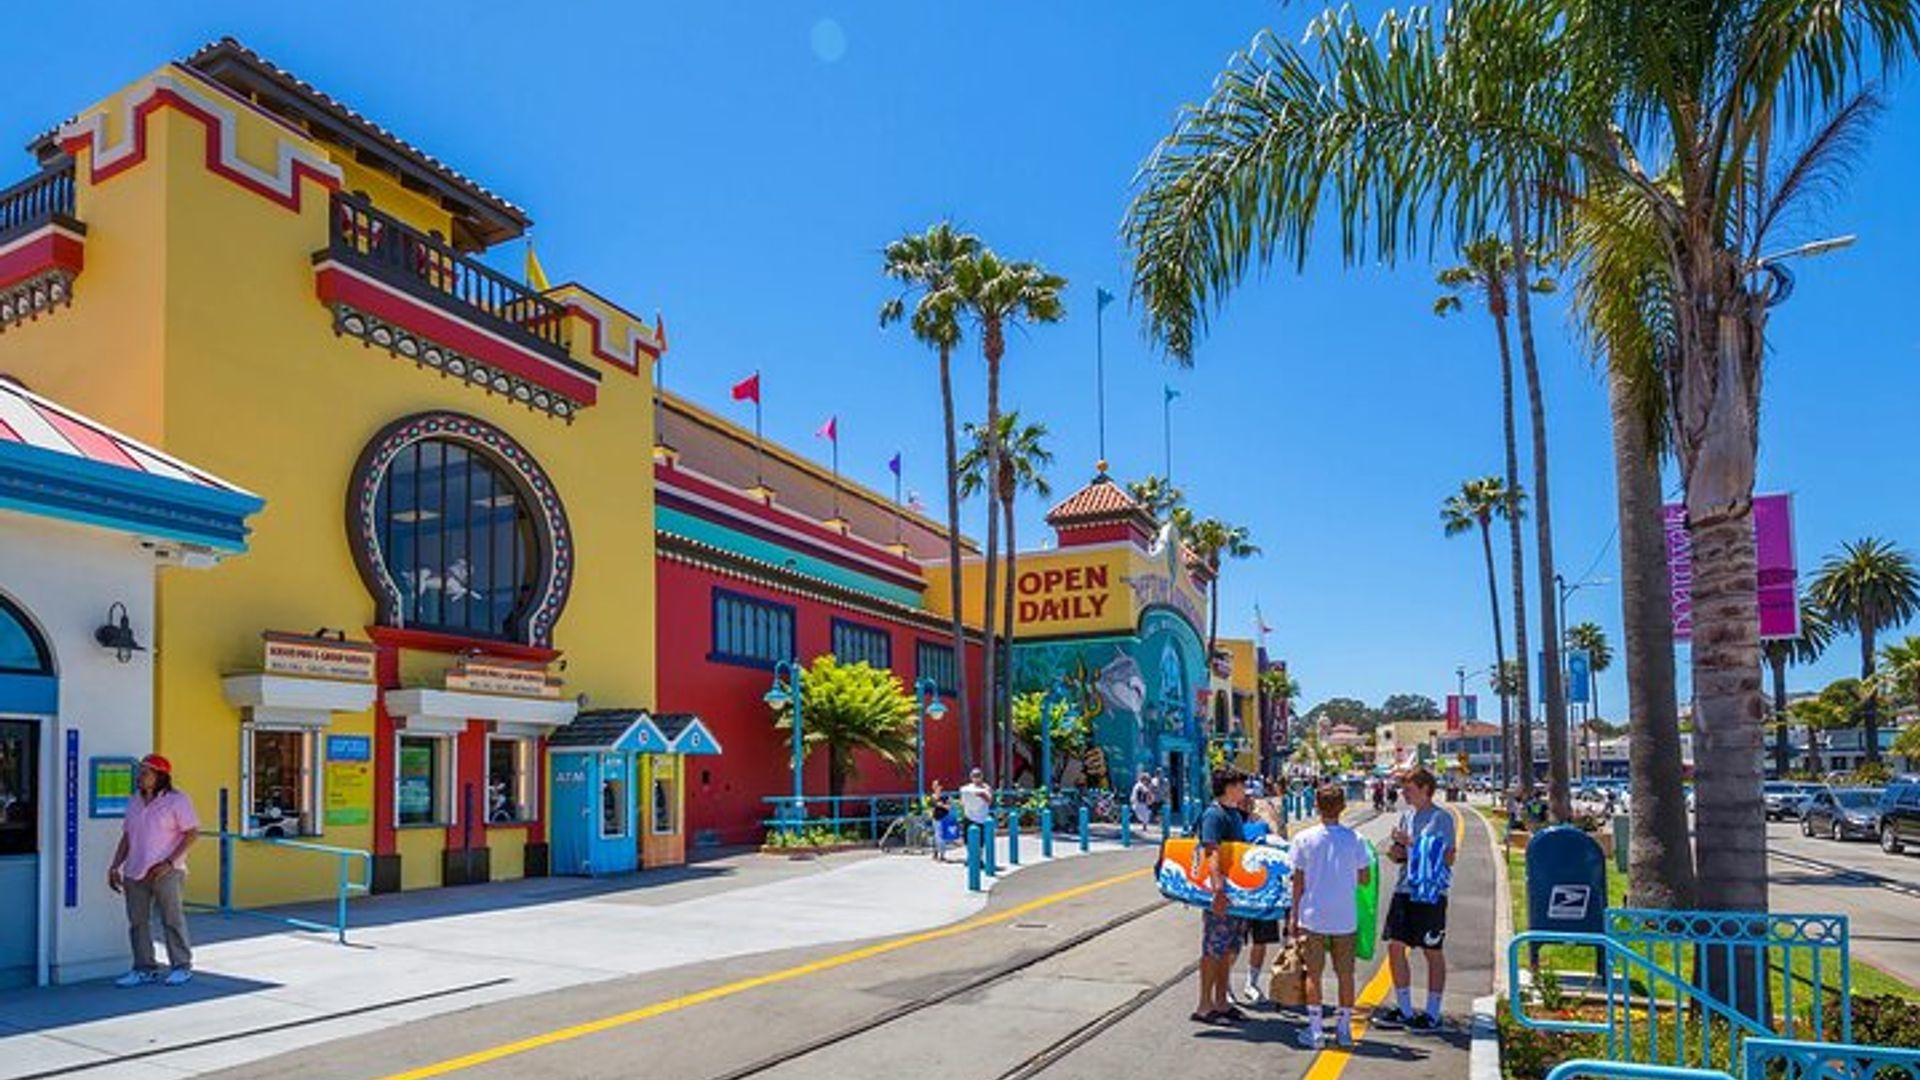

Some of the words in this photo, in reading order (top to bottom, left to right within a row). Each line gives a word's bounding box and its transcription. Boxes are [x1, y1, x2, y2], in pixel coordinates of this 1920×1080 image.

[1018, 565, 1108, 595] OPEN
[1019, 594, 1109, 623] DAILY
[556, 771, 586, 783] ATM
